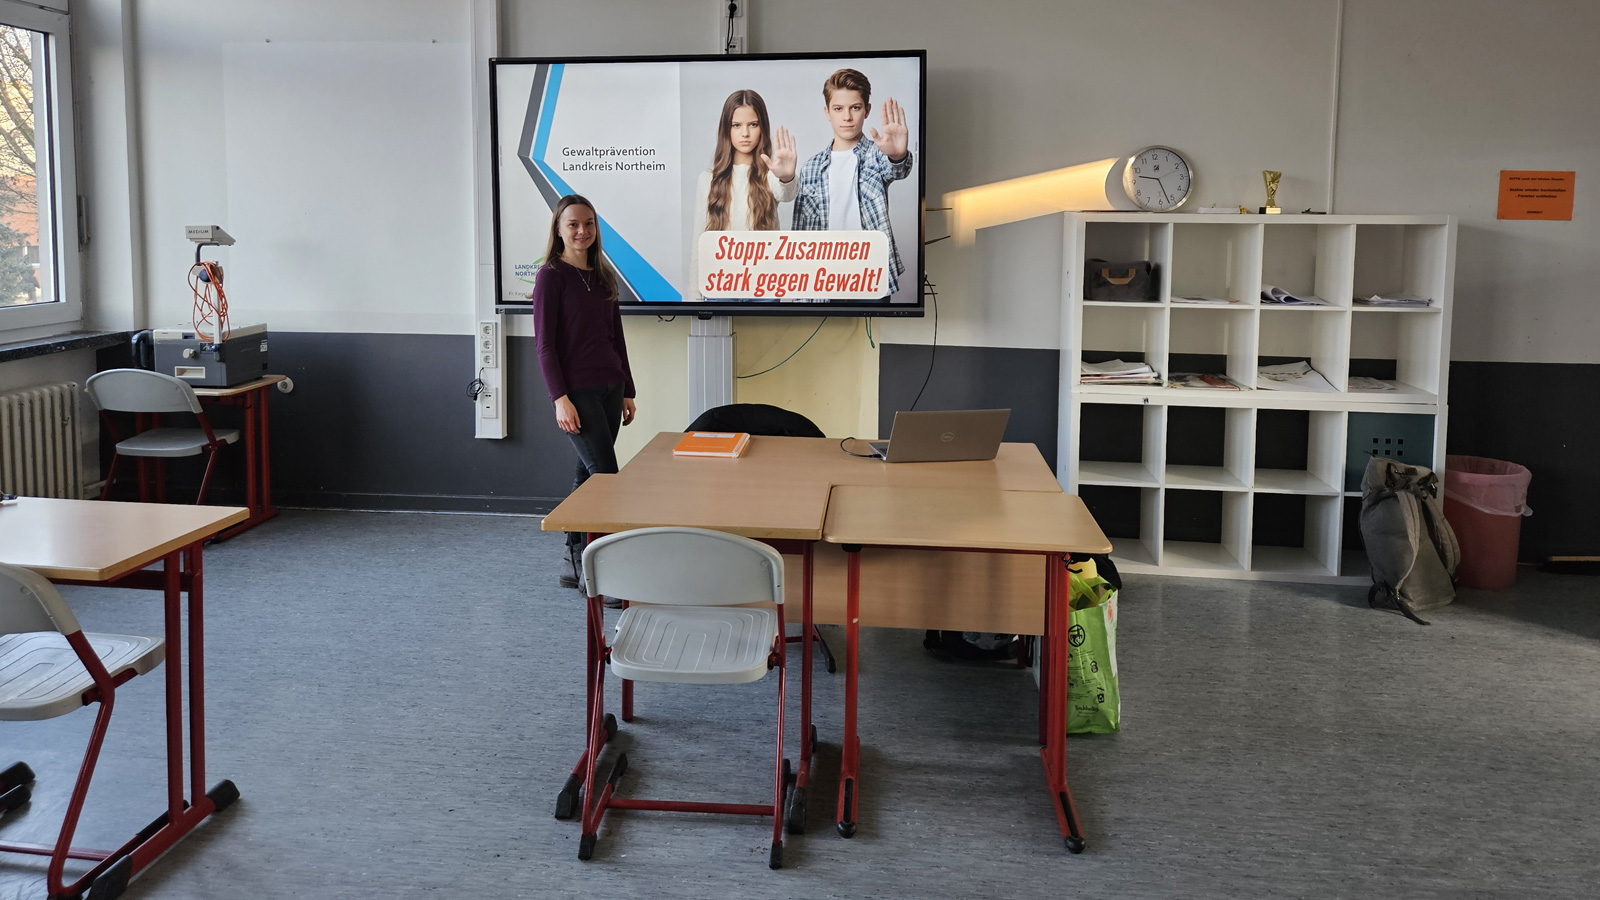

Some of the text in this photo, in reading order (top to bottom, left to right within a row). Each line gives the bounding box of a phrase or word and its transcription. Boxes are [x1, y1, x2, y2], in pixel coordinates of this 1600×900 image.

[562, 146, 656, 158] Gewaltprävention
[562, 161, 666, 171] Landkreis Northeim
[715, 235, 871, 266] Stopp: Zusammen
[705, 267, 883, 298] stark gegen Gewalt!
